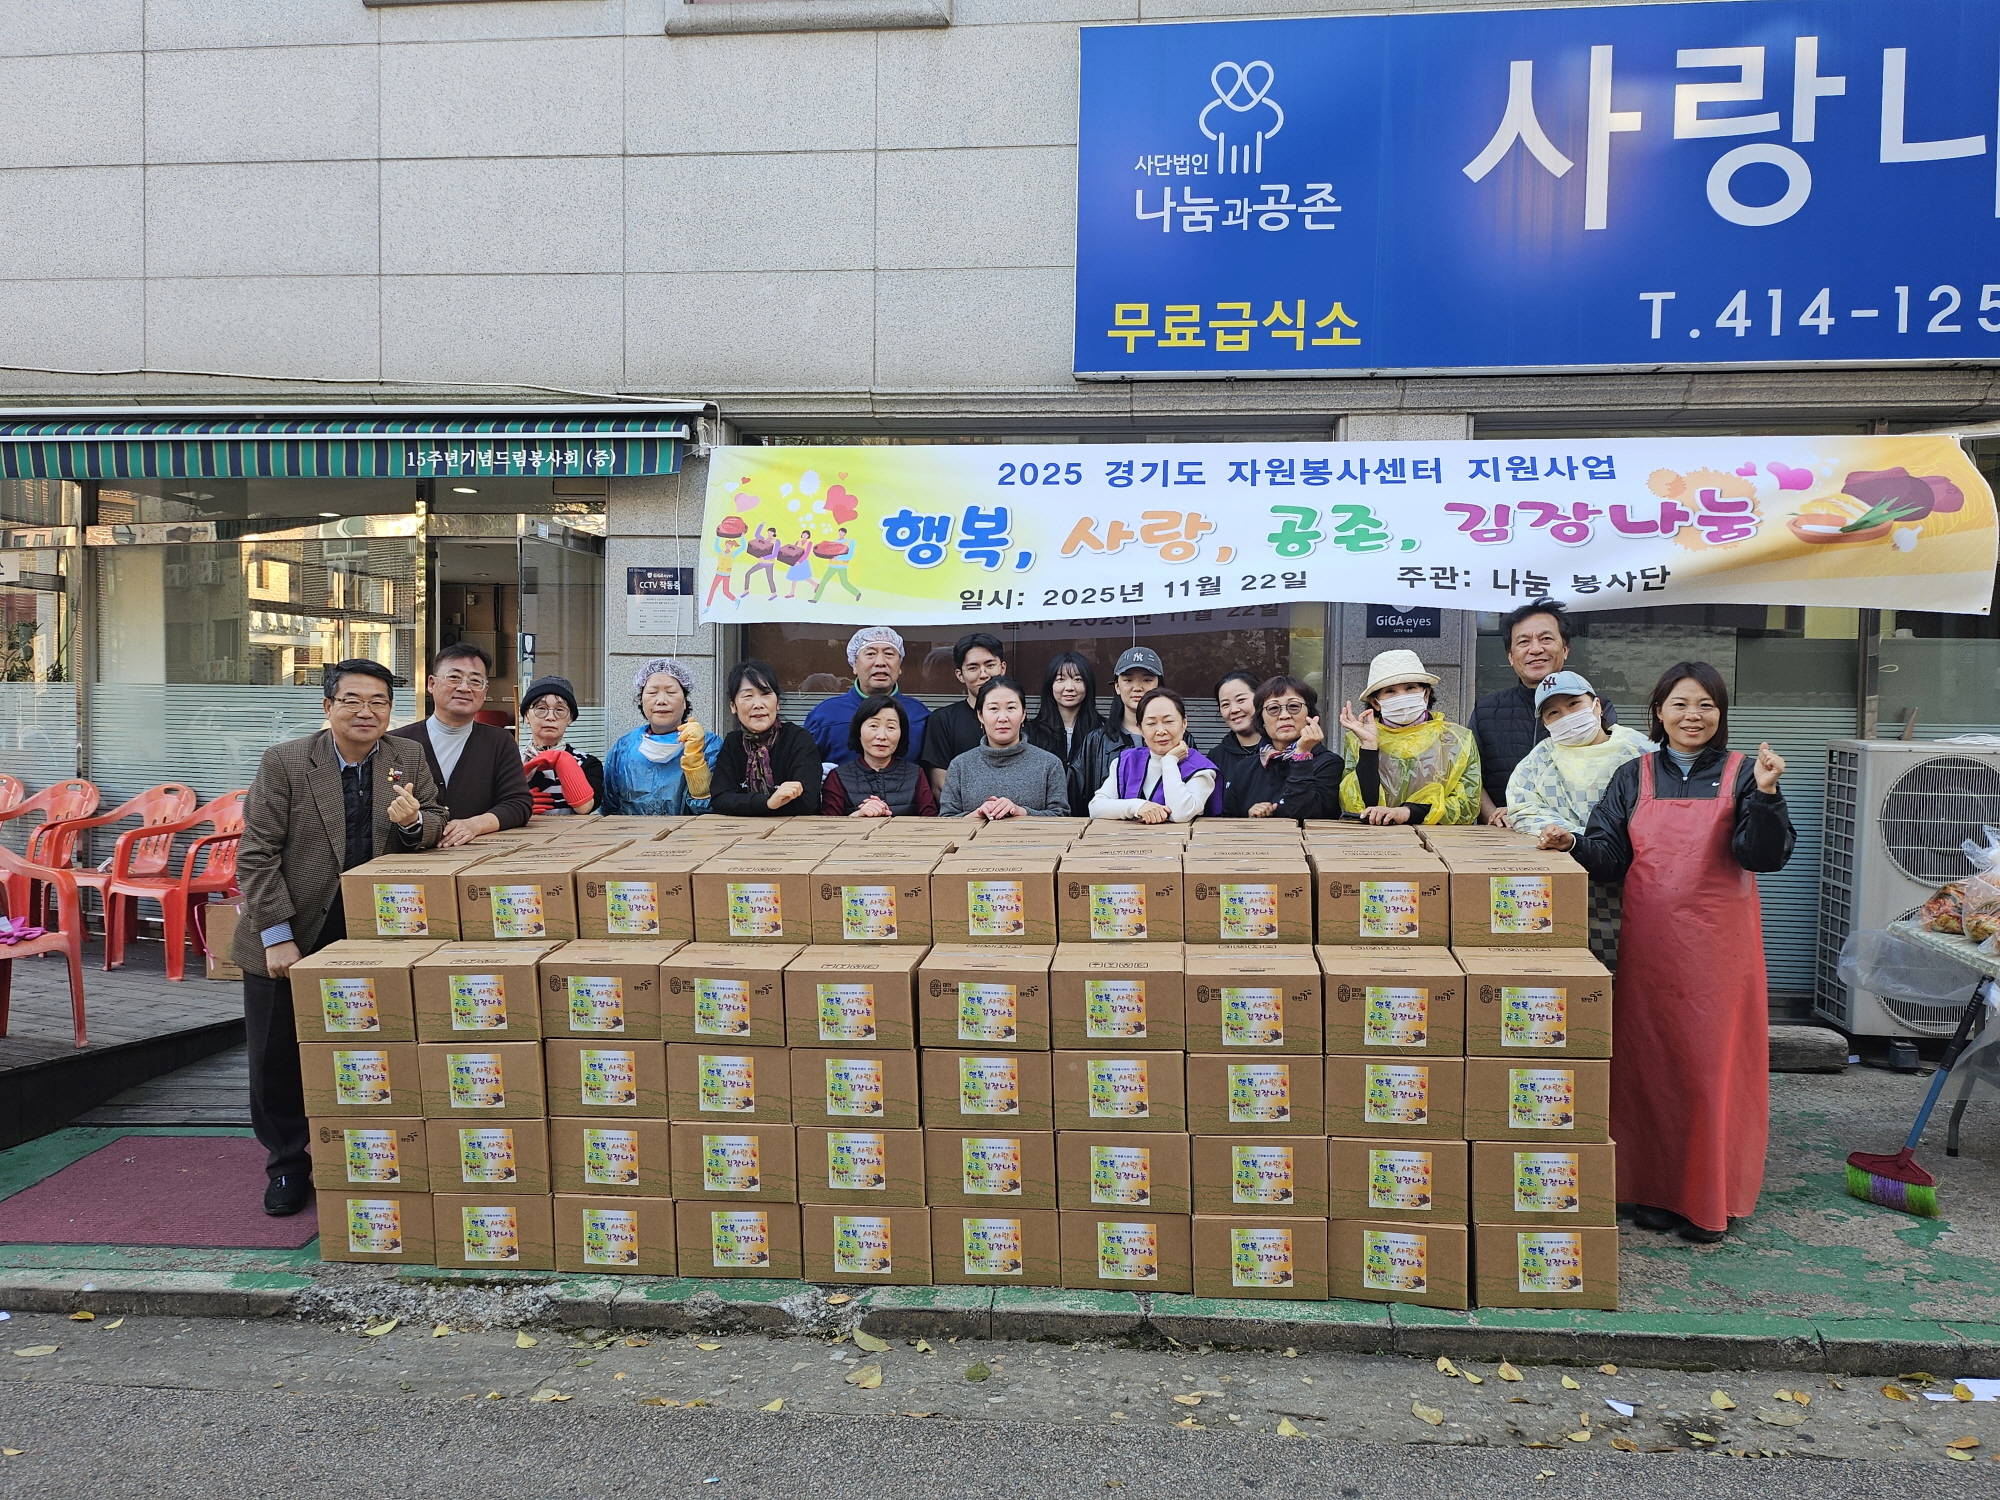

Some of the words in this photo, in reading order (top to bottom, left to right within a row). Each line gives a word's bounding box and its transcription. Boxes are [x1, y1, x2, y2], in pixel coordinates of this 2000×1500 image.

[1134, 153, 1208, 176] 사단법인
[1135, 183, 1342, 233] 나눔과공존
[1106, 298, 1363, 353] 무료급식소
[407, 449, 578, 468] 15주년기념드림봉사회
[586, 448, 616, 468] (증)
[998, 461, 1083, 487] 2025
[1104, 459, 1207, 488] 경기도
[1227, 456, 1441, 488] 자원봉사센터
[1468, 453, 1618, 483] 지원사업
[882, 505, 1035, 571] 행복,
[1062, 507, 1237, 565] 사랑,
[1268, 503, 1421, 559] 공존,
[1444, 488, 1761, 546] 김장나눔
[639, 581, 658, 589] CCTV
[1396, 565, 1472, 591] 주관:
[1492, 568, 1550, 598] 나눔
[1570, 565, 1671, 594] 봉사단
[959, 588, 1025, 610] 일시:
[1042, 582, 1146, 607] 2025년
[1164, 575, 1222, 598] 11월
[1240, 570, 1309, 591] 22일
[1369, 894, 1387, 902] 행복,
[1500, 889, 1519, 898] 행복,
[1098, 896, 1116, 905] 행복,
[1229, 896, 1246, 905] 행복,
[1515, 899, 1548, 909] 김장나눔
[1112, 906, 1142, 915] 김장나눔
[1243, 907, 1274, 915] 김장나눔
[1384, 905, 1415, 914] 김장나눔
[1095, 993, 1113, 1002] 행복,
[1110, 1004, 1142, 1013] 김장나눔
[1231, 1001, 1250, 1010] 행복,
[1375, 1000, 1394, 1009] 행복,
[1511, 1001, 1531, 1010] 행복,
[1246, 1012, 1279, 1021] 김장나눔
[1390, 1012, 1423, 1021] 김장나눔
[1527, 1013, 1562, 1022] 김장나눔
[1097, 1073, 1115, 1082] 행복,
[1238, 1077, 1256, 1086] 행복,
[1375, 1078, 1394, 1087] 행복,
[1519, 1082, 1539, 1091] 행복,
[1112, 1084, 1144, 1093] 김장나눔
[1253, 1088, 1285, 1098] 김장나눔
[1390, 1090, 1424, 1099] 김장나눔
[1535, 1094, 1569, 1103] 김장나눔
[1100, 1159, 1118, 1168] 행복,
[1242, 1159, 1260, 1168] 행복,
[1379, 1163, 1398, 1172] 행복,
[1257, 1171, 1289, 1179] 김장나눔
[1524, 1166, 1544, 1175] 행복,
[1114, 1171, 1146, 1180] 김장나눔
[1394, 1175, 1427, 1185] 김장나눔
[1540, 1178, 1574, 1187] 김장나눔
[1107, 1235, 1125, 1244] 행복,
[1241, 1242, 1259, 1251] 행복,
[1373, 1244, 1392, 1254] 행복,
[1528, 1246, 1547, 1255] 행복,
[1122, 1247, 1153, 1256] 김장나눔
[1256, 1253, 1288, 1262] 김장나눔
[1544, 1257, 1578, 1267] 김장나눔
[1389, 1257, 1422, 1268] 김장나눔
